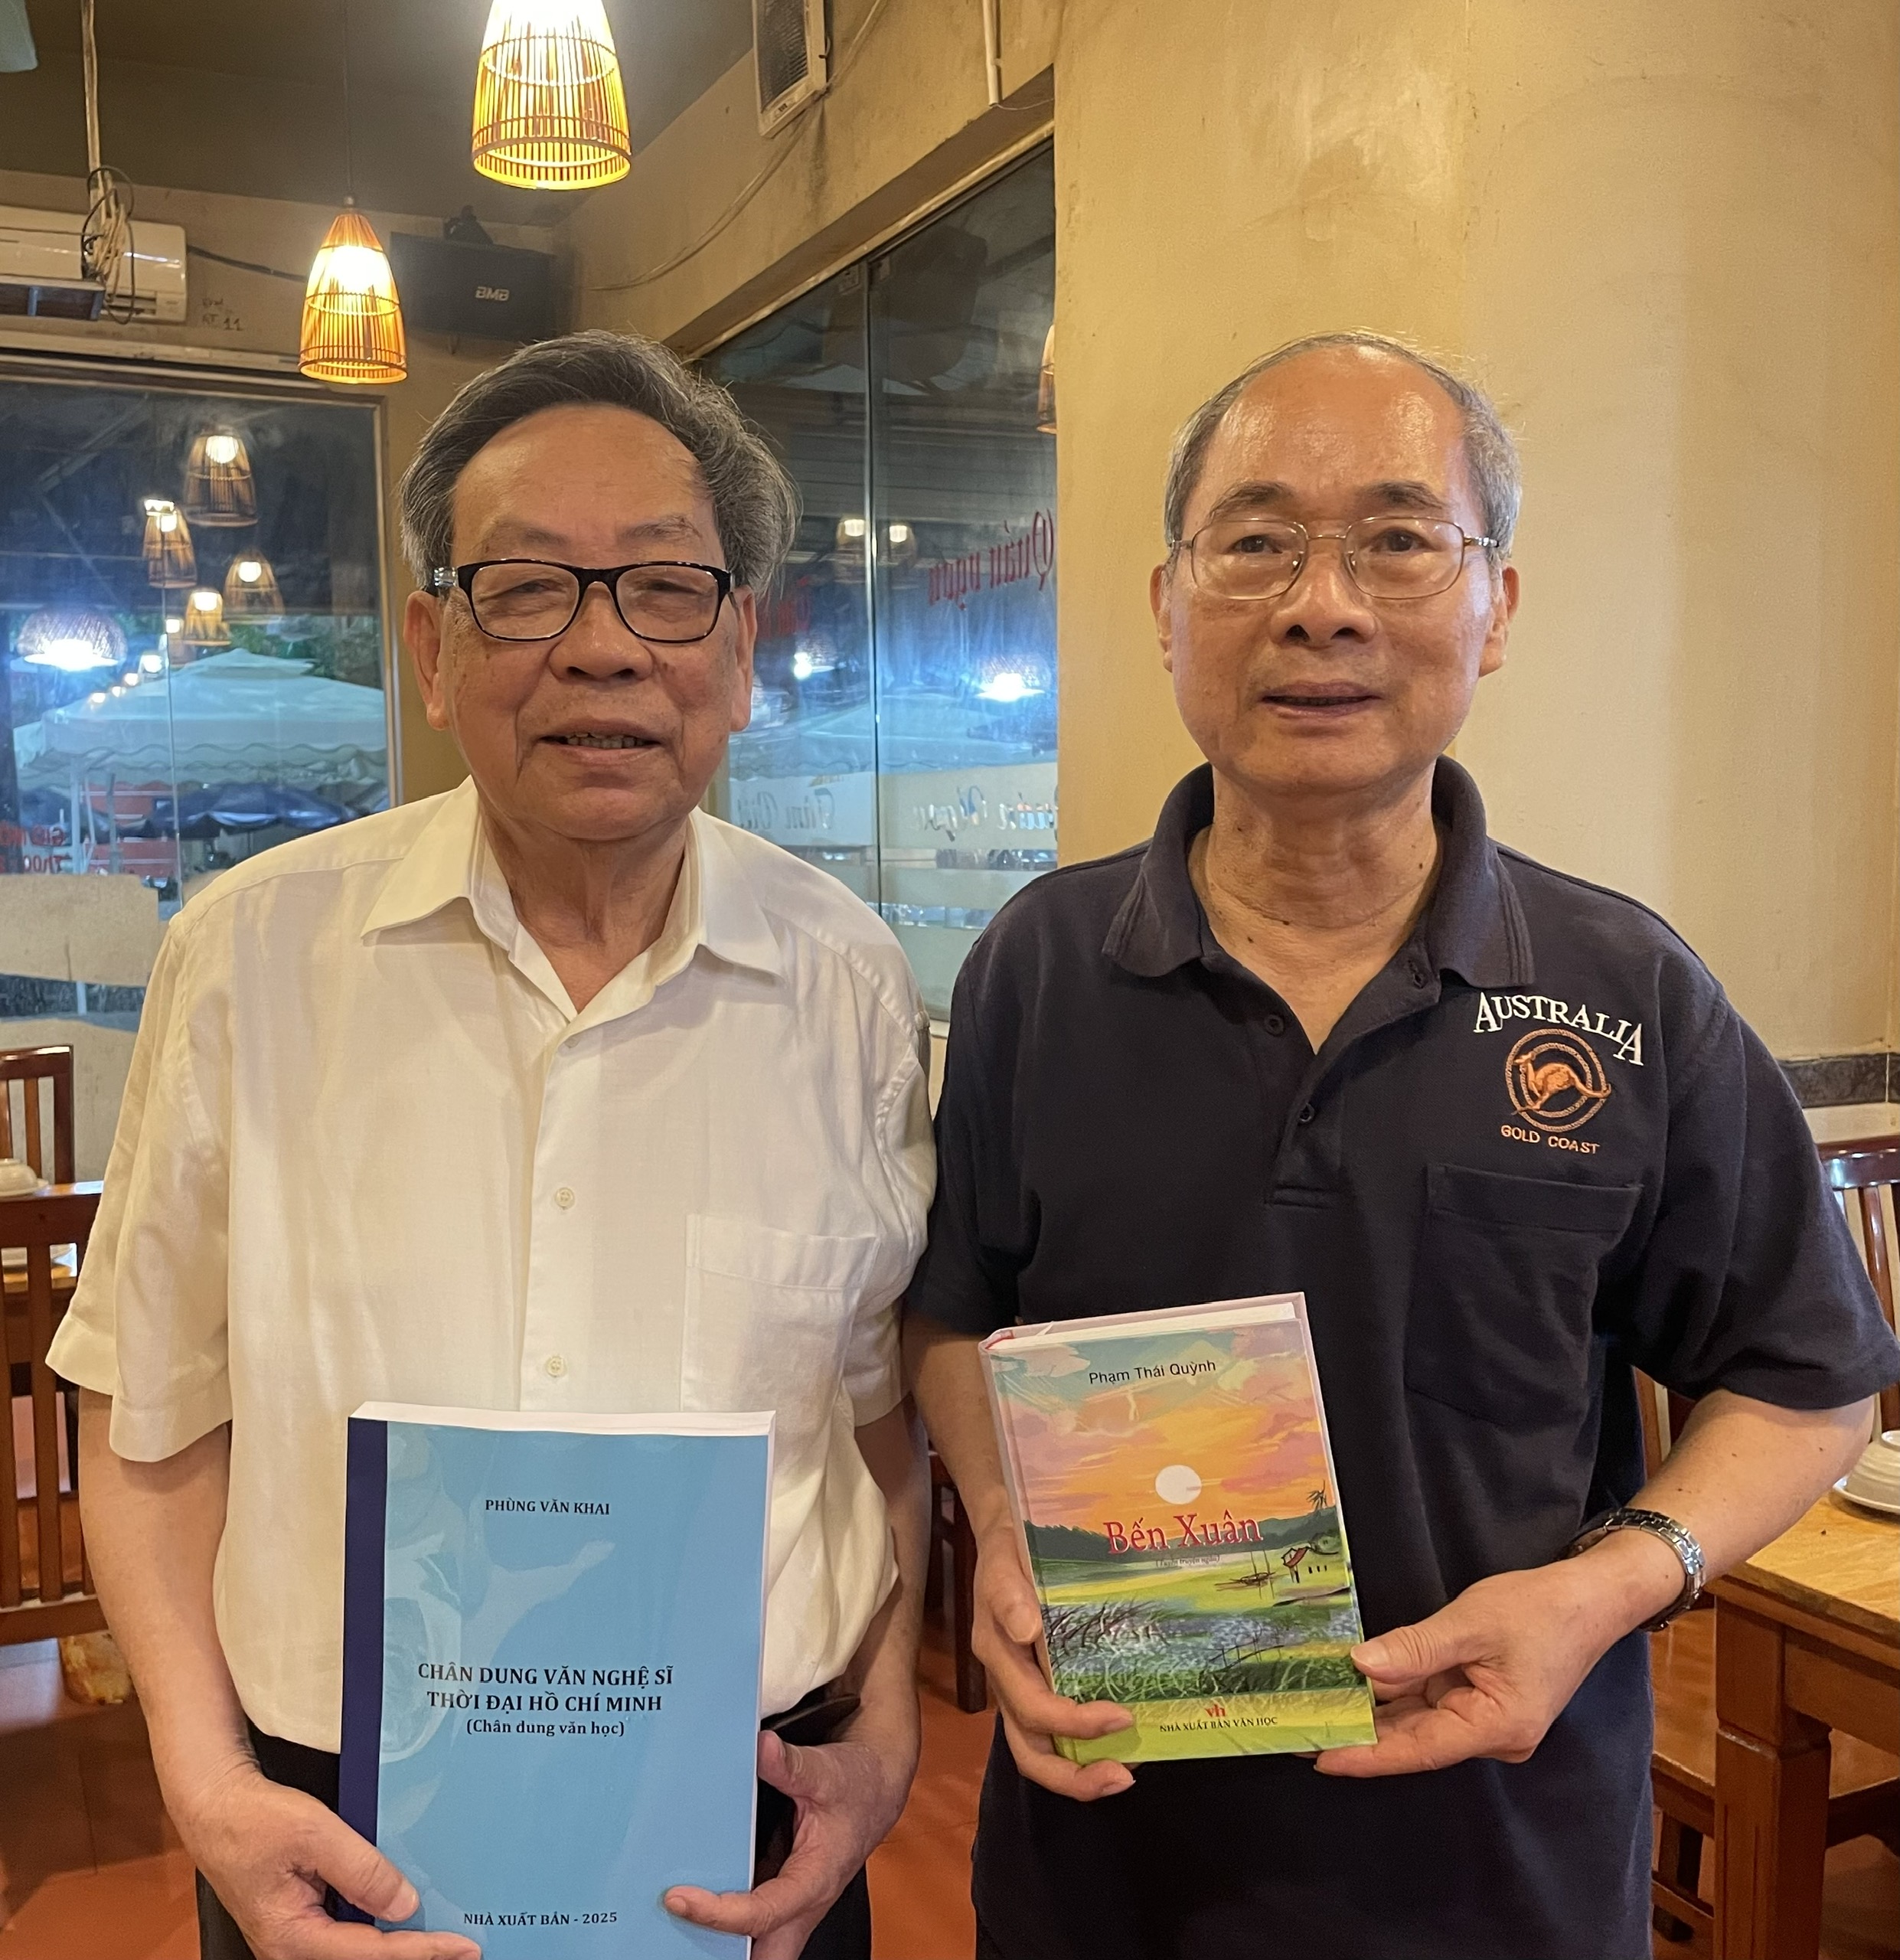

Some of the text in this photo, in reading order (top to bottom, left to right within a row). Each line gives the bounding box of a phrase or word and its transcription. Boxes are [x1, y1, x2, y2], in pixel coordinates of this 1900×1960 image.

[475, 286, 510, 301] BMB
[1473, 991, 1644, 1067] AUSTRALIA
[1500, 1125, 1601, 1155] GOLD COAST
[1089, 1360, 1216, 1384] Phạm Thái Quỳnh
[485, 1498, 610, 1515] PHÙNG VĂN KHAI
[1103, 1509, 1264, 1554] Bến Xuân
[418, 1661, 674, 1689] CHÂN DUNG VĂN NGHỆ SĨ
[427, 1689, 661, 1714] THỜI ĐẠI HỒ CHÍ MINH
[466, 1719, 625, 1737] (Chân dung văn học)
[1160, 1717, 1278, 1732] NHÀ XUẤT BẢN VĂN HỌC
[463, 1912, 494, 1926] NHÀ
[498, 1912, 537, 1926] XUẤT
[540, 1911, 570, 1926] BẢN
[582, 1912, 617, 1924] 2025
